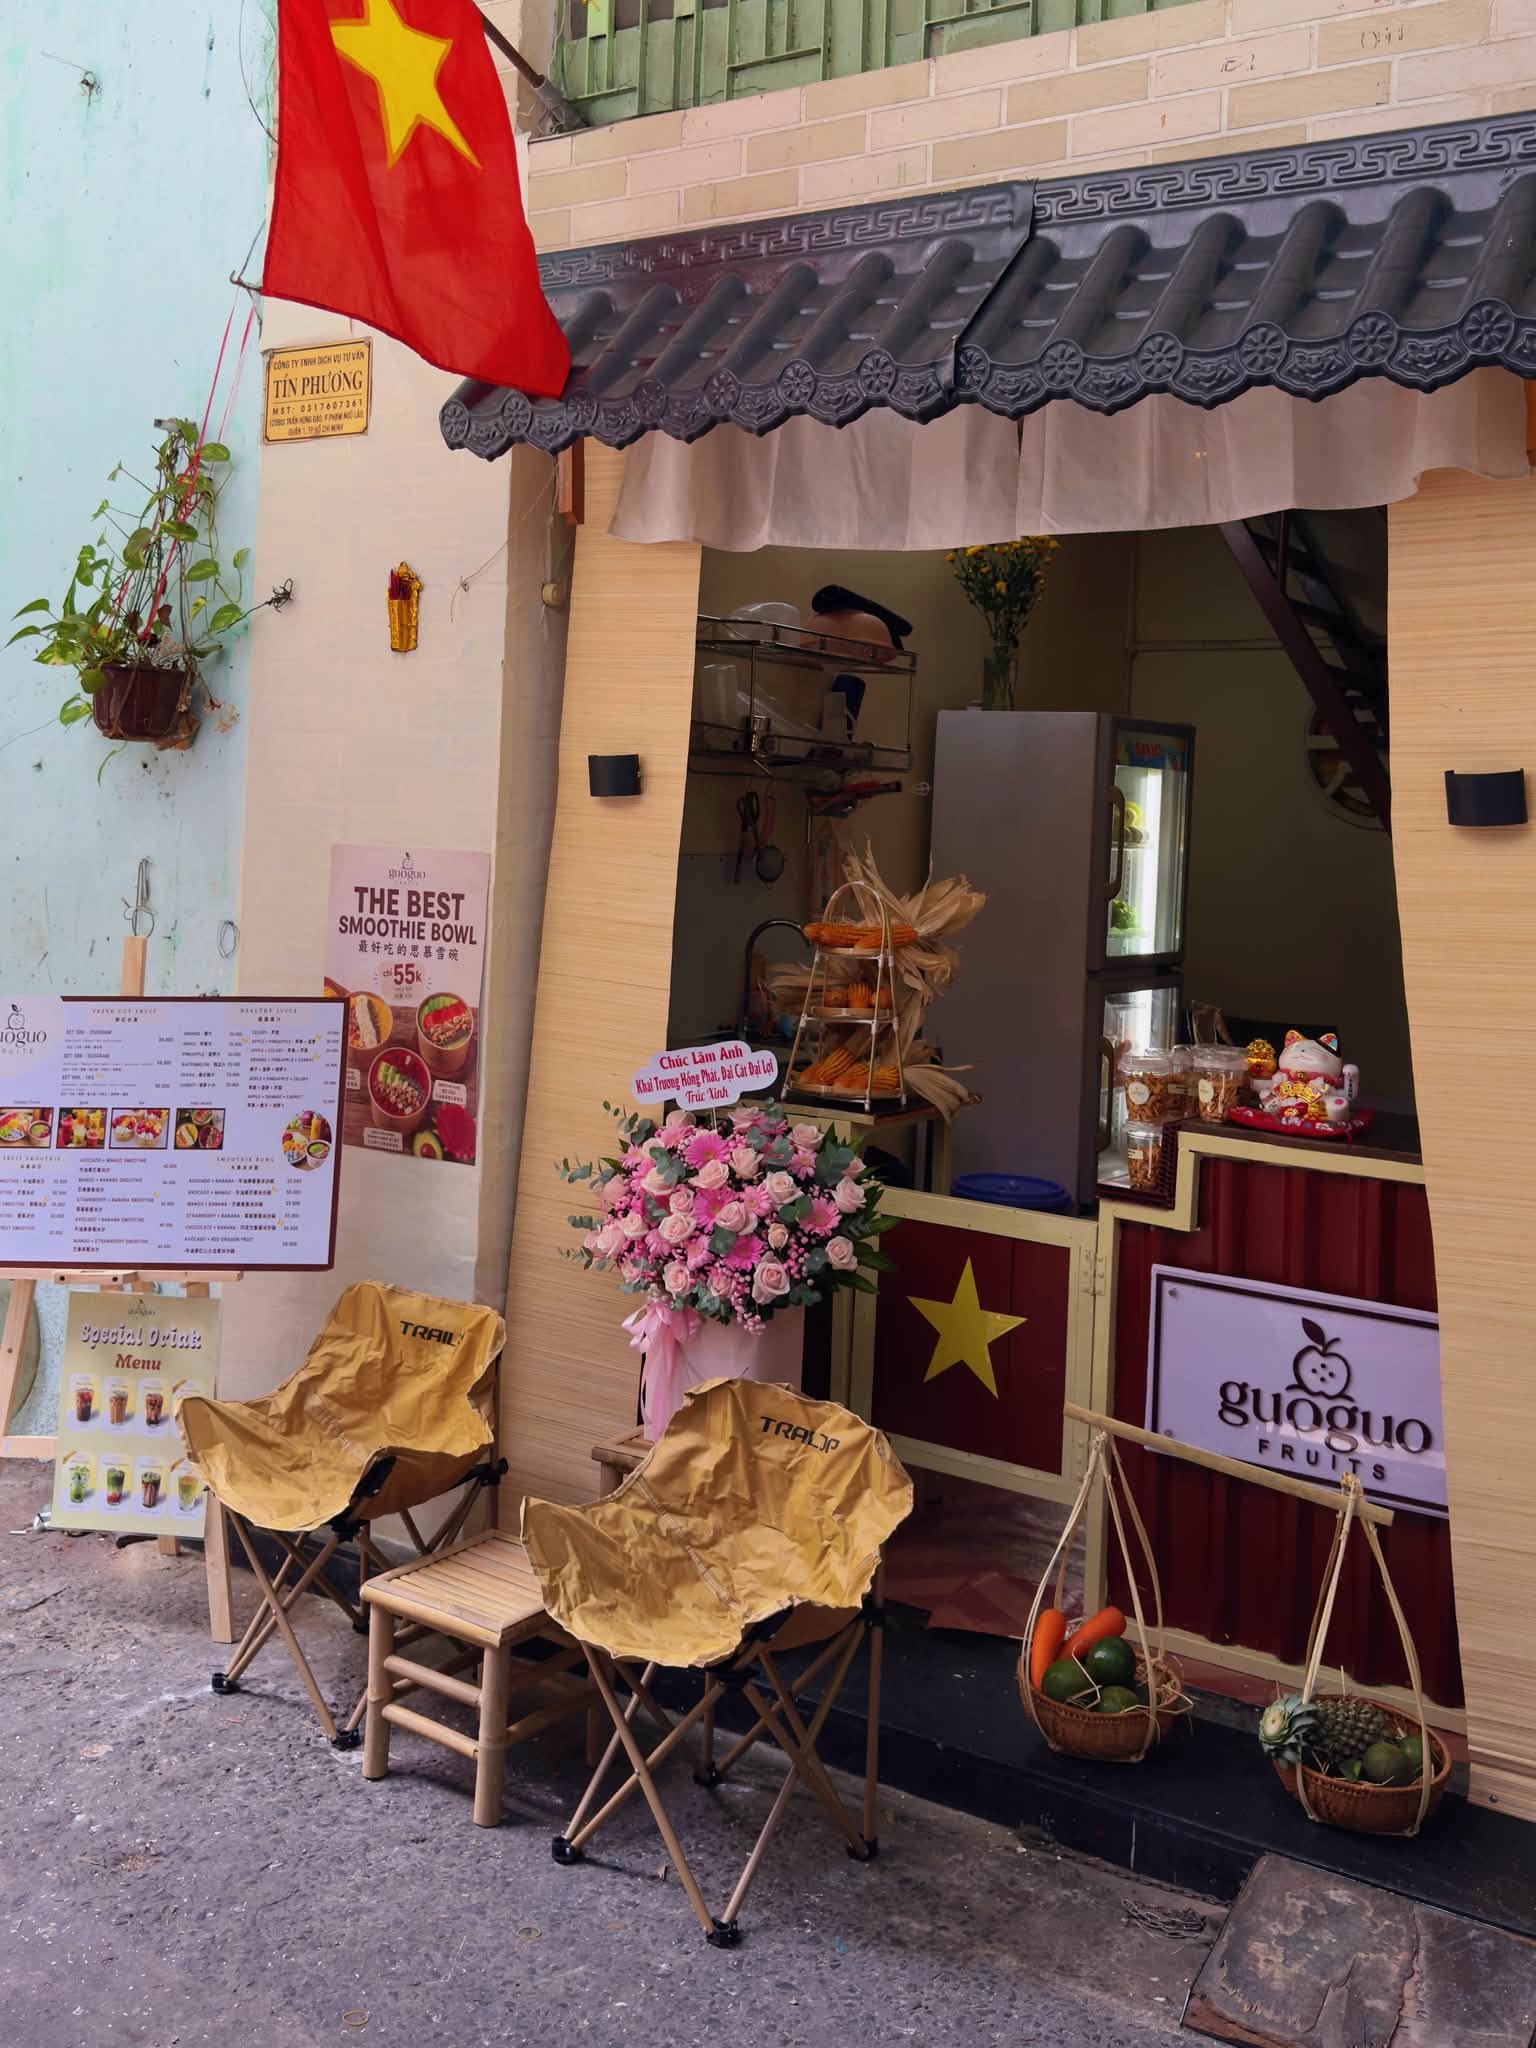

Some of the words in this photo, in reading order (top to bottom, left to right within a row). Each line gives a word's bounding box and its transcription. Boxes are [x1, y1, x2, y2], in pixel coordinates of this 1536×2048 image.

[291, 359, 299, 368] TY
[273, 373, 298, 398] TÍN
[302, 370, 363, 396] PHƯƠNG
[354, 886, 399, 916] THE
[407, 889, 465, 920] BEST
[339, 915, 426, 940] SMOOTHIE
[431, 923, 477, 945] BOWL
[358, 940, 460, 962] 最好吃的思慕雪碗
[394, 963, 422, 985] 55k
[0, 1031, 47, 1048] oguo
[659, 1055, 689, 1070] Chúc
[720, 1044, 743, 1060] Anh
[635, 1077, 653, 1093] Khai
[735, 1062, 748, 1078] Cát
[81, 1323, 143, 1350] Special
[149, 1327, 202, 1350] Drink
[115, 1353, 161, 1371] Menu
[1218, 1380, 1433, 1454] guoguo
[1258, 1439, 1387, 1481] FRUITS
